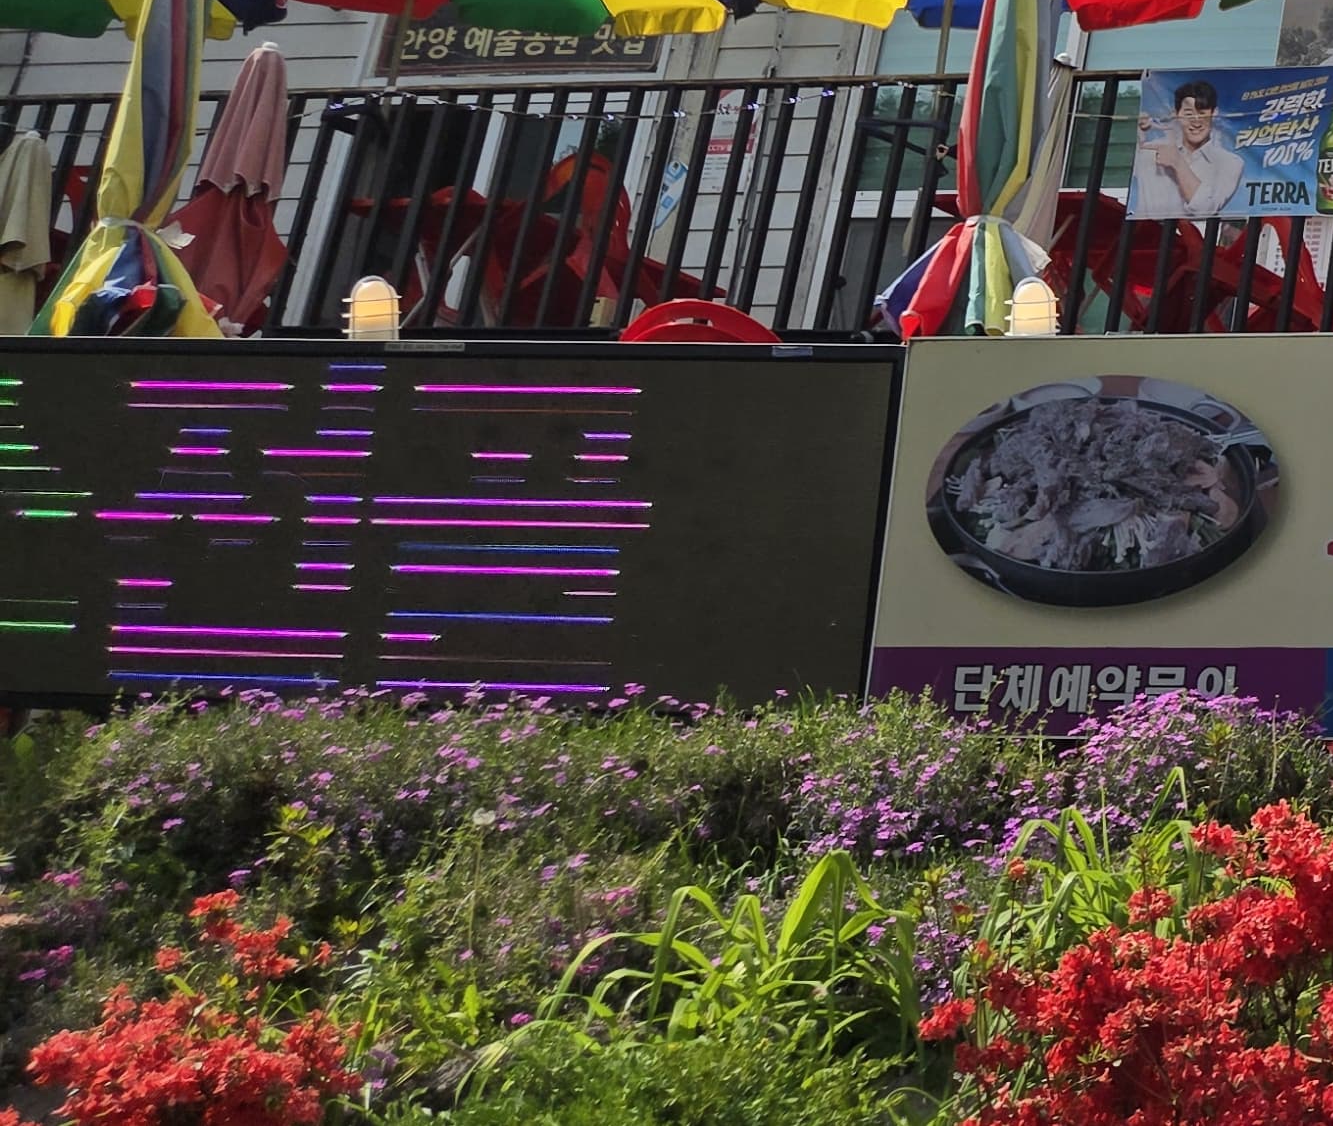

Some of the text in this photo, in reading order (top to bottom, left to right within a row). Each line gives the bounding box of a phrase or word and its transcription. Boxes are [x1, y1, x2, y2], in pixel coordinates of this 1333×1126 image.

[399, 26, 457, 61] 안양
[1262, 138, 1317, 169] 100%
[1245, 180, 1311, 207] TERRA
